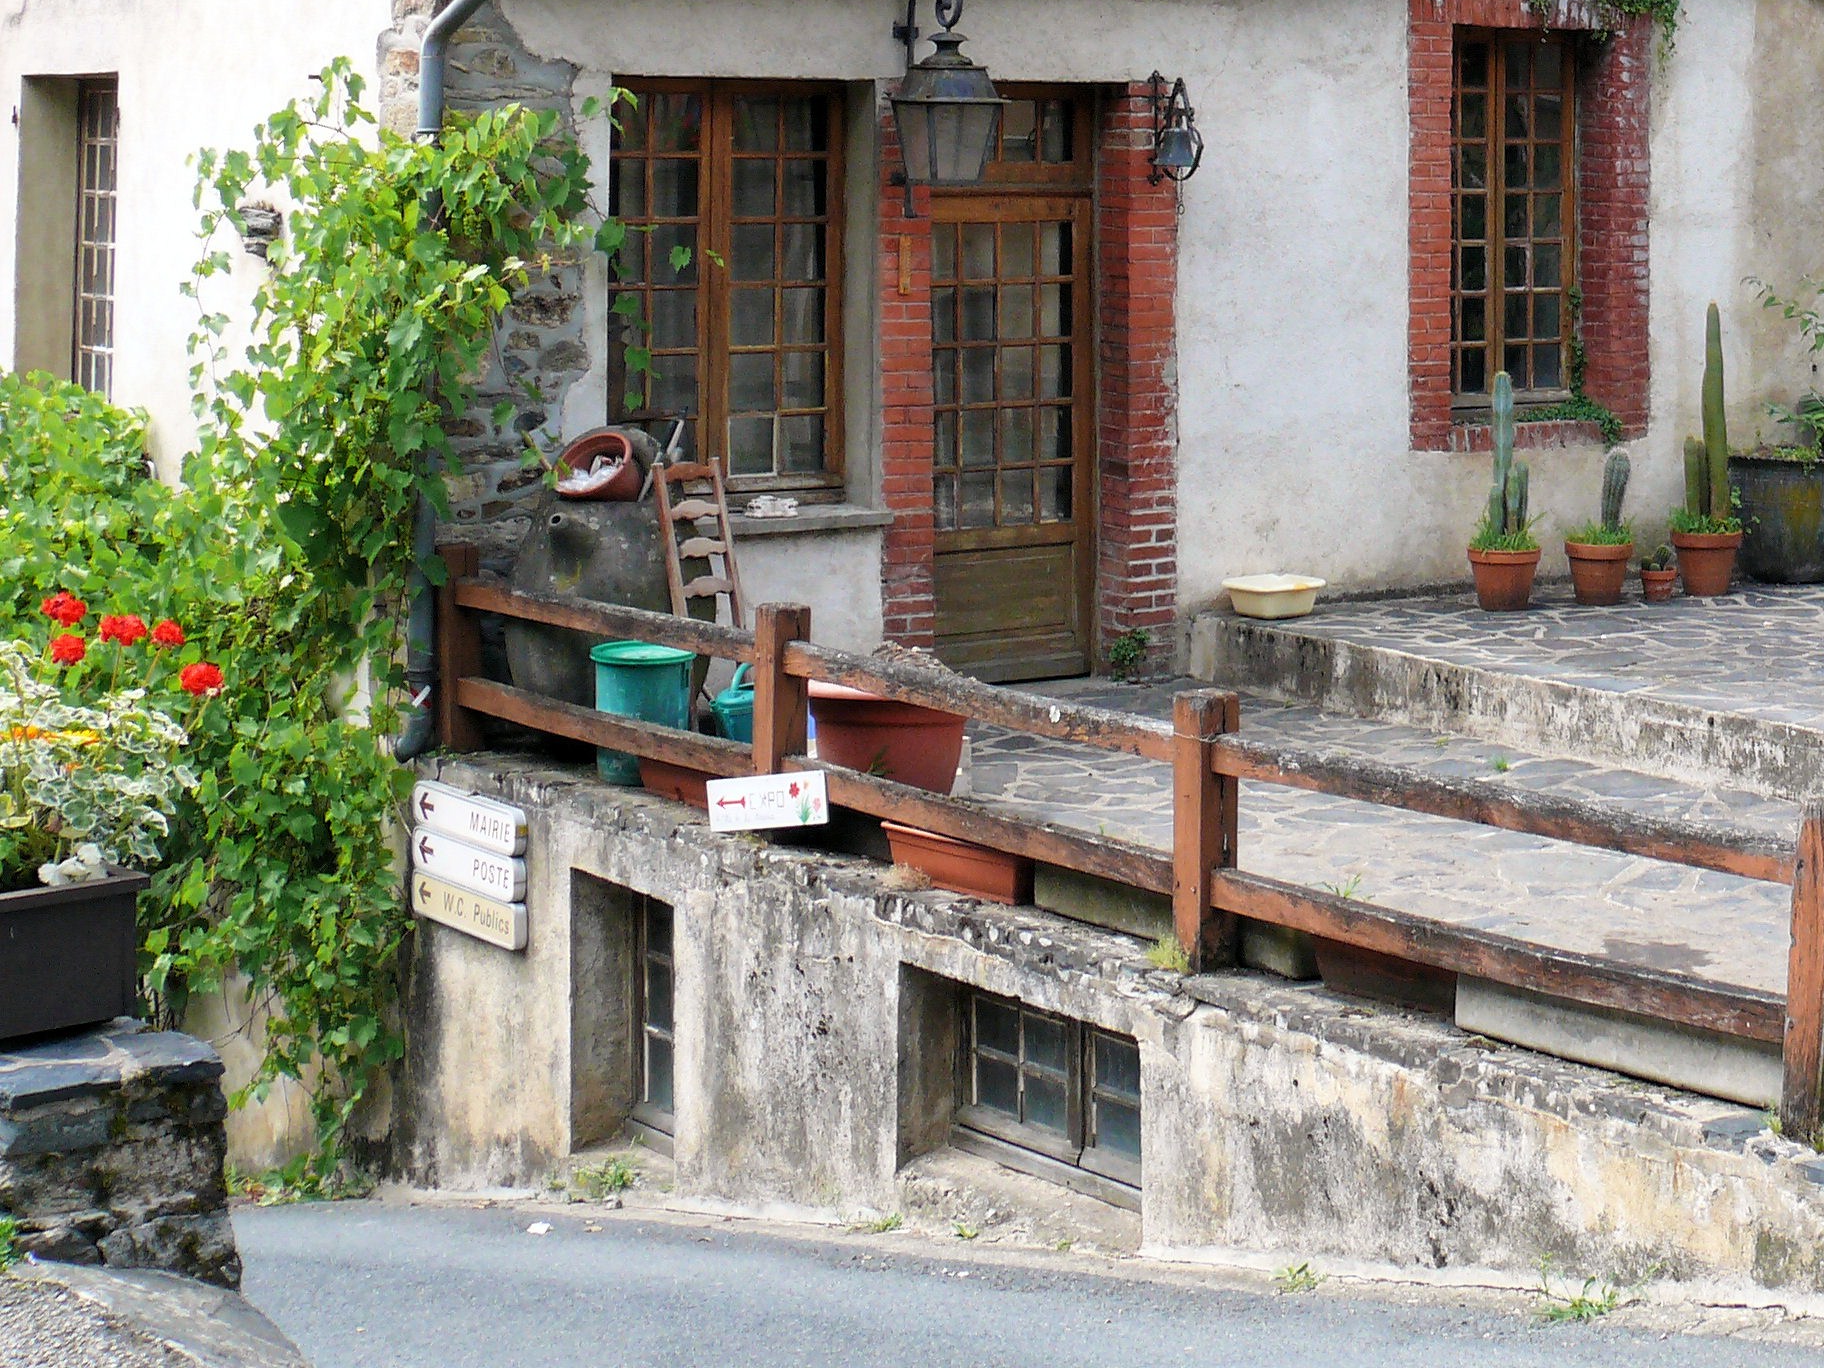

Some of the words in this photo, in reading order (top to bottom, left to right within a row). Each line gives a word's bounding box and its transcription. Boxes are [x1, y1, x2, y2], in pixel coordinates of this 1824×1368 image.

[749, 790, 785, 810] EXPO
[469, 811, 510, 843] MAIRIE
[472, 858, 510, 889] POSTE
[443, 891, 467, 919] W.C.
[473, 903, 510, 935] Publics
